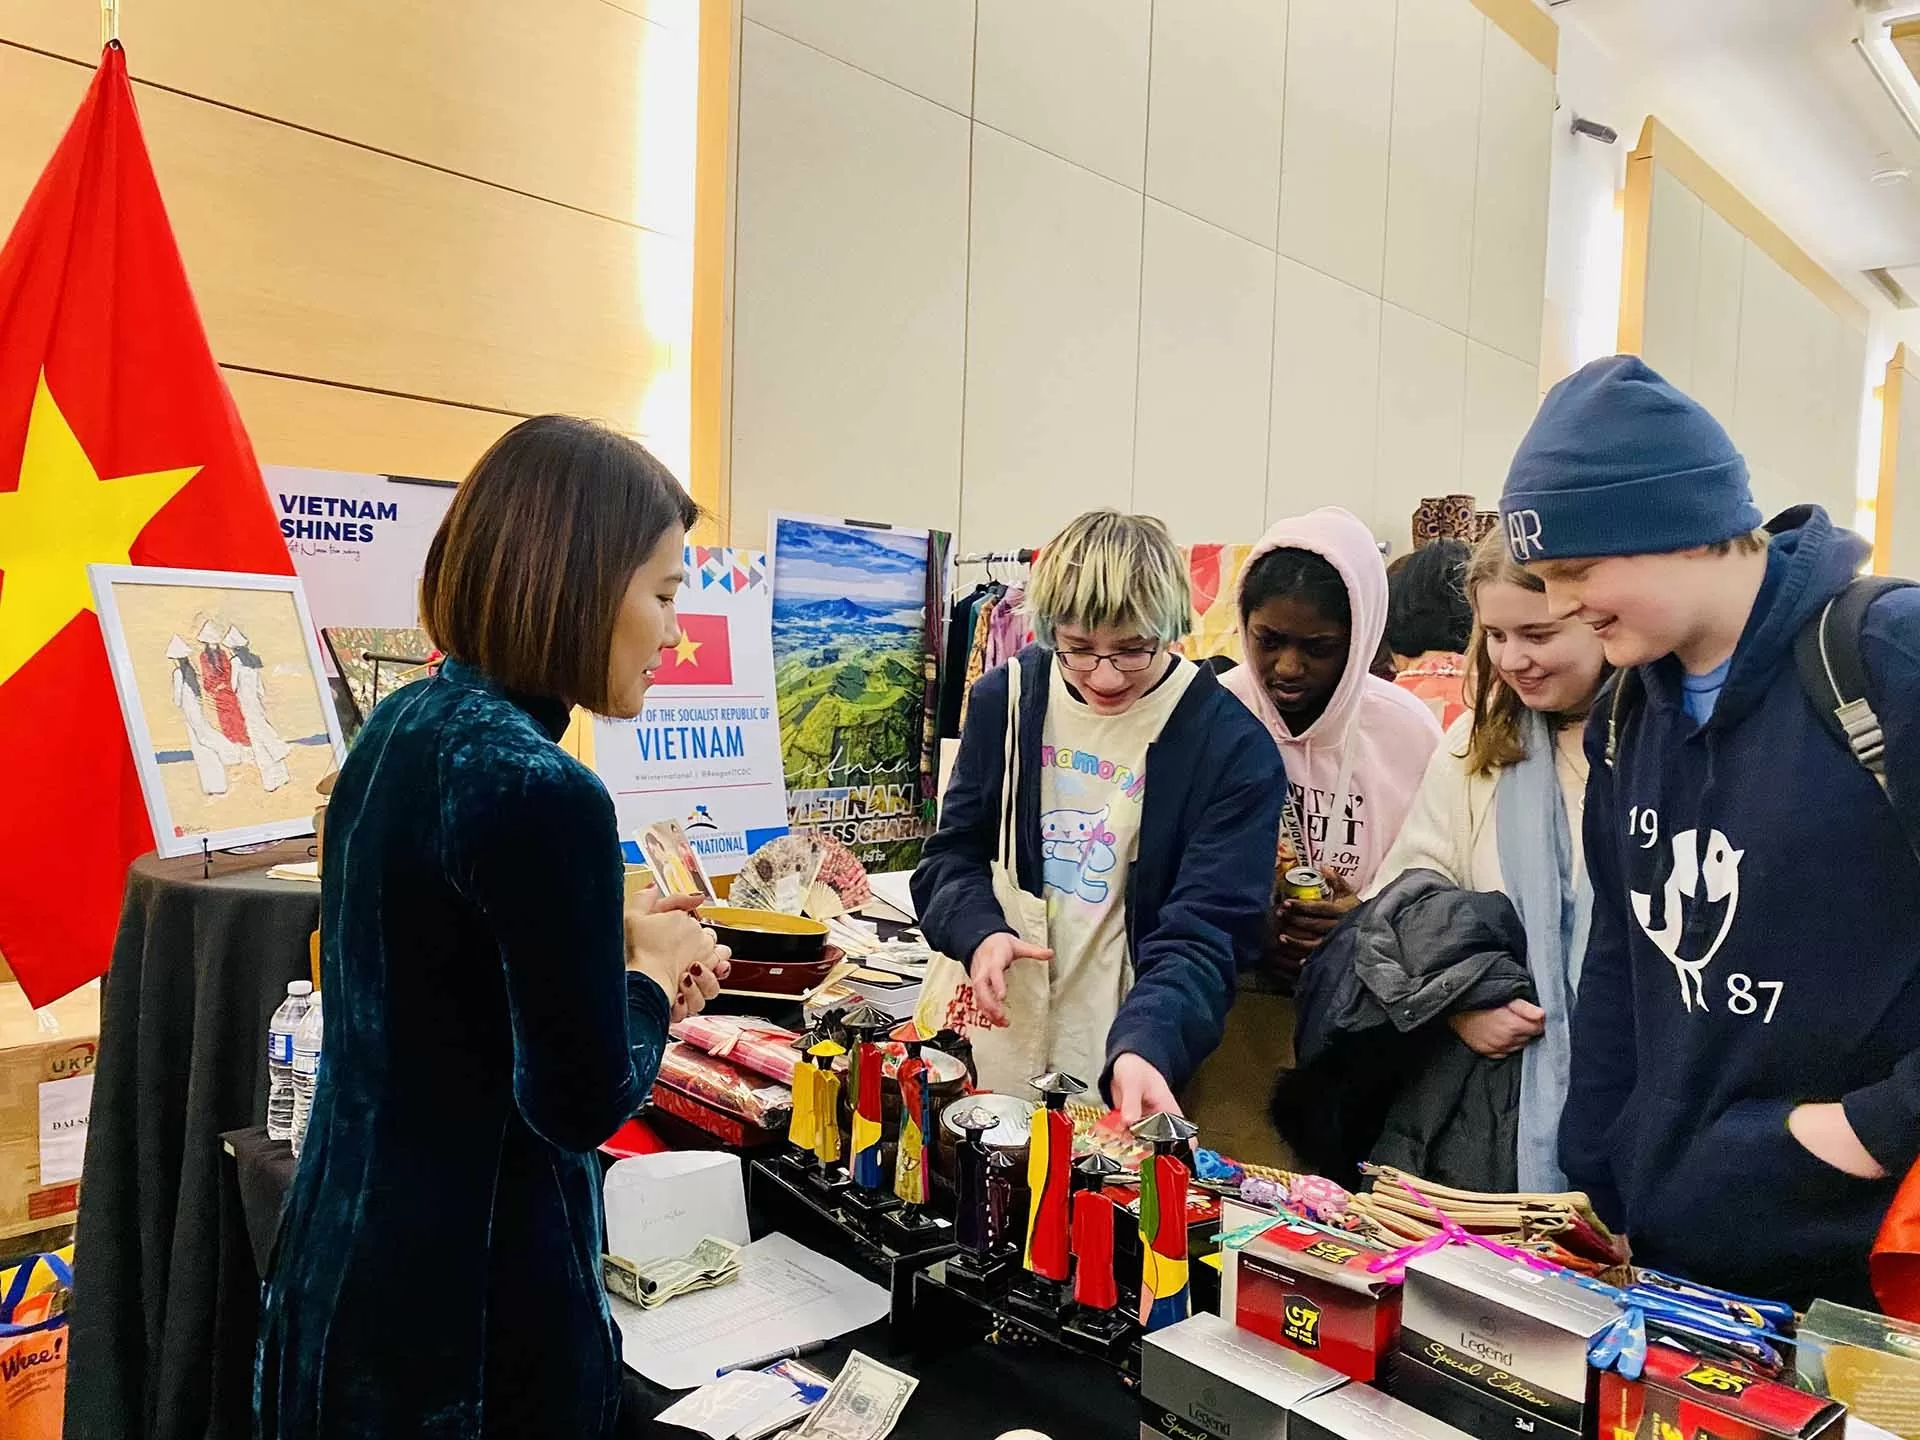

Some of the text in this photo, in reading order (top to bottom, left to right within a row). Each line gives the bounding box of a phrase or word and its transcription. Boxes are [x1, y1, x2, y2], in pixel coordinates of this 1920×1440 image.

[279, 494, 398, 521] VIETNAM
[279, 518, 374, 542] SHINES
[646, 708, 657, 722] OF
[660, 708, 676, 722] THE
[678, 708, 719, 722] SOCIALIST
[721, 707, 757, 721] REPUBLIC
[760, 707, 770, 720] OF
[637, 726, 745, 761] VIETNAM
[786, 784, 914, 824] VIETNAM
[1629, 805, 1659, 849] 19
[1727, 972, 1784, 1024] 87
[1285, 1305, 1320, 1332] G7
[1460, 1332, 1513, 1367] Legend
[1424, 1342, 1550, 1407] Special Edition
[1188, 1402, 1231, 1438] Legend
